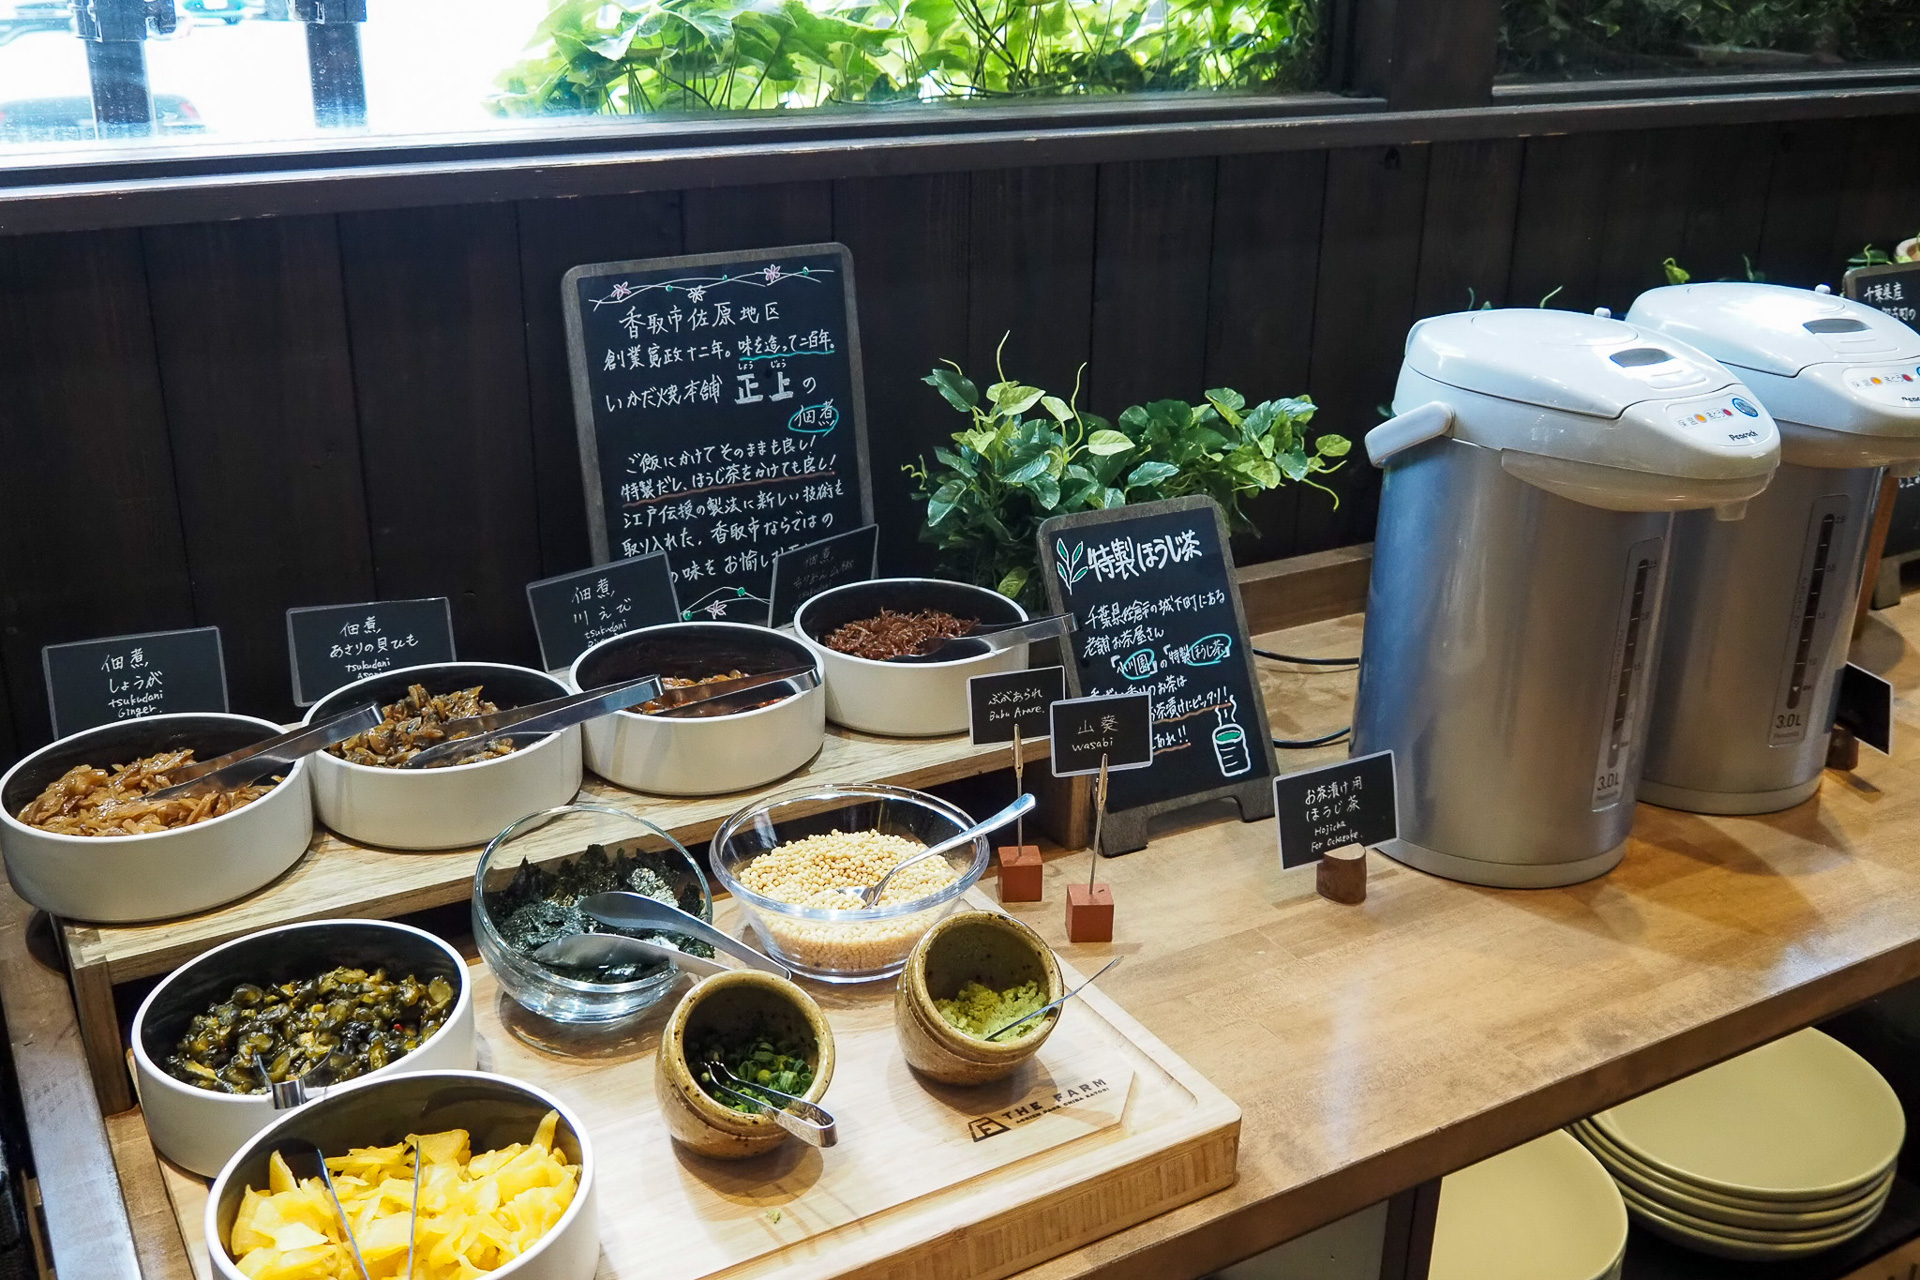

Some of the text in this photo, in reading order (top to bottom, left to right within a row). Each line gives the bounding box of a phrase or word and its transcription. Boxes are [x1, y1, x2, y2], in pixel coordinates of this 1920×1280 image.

[619, 302, 780, 339] 香取市佐原地区
[794, 399, 835, 427] 佃煮
[1087, 529, 1202, 582] 特製ほうじ茶
[572, 578, 615, 604] 佃煮
[573, 597, 632, 626] 川えび
[339, 615, 381, 637] 佃煮
[329, 633, 419, 658] あさりの貝ひも
[101, 647, 149, 672] 佃煮
[109, 670, 163, 693] しょうが
[108, 690, 163, 708] tsukudani
[1305, 775, 1363, 805] お茶漬け用
[1306, 795, 1360, 822] ほうじ茶
[1001, 1079, 1107, 1120] THE FARM
